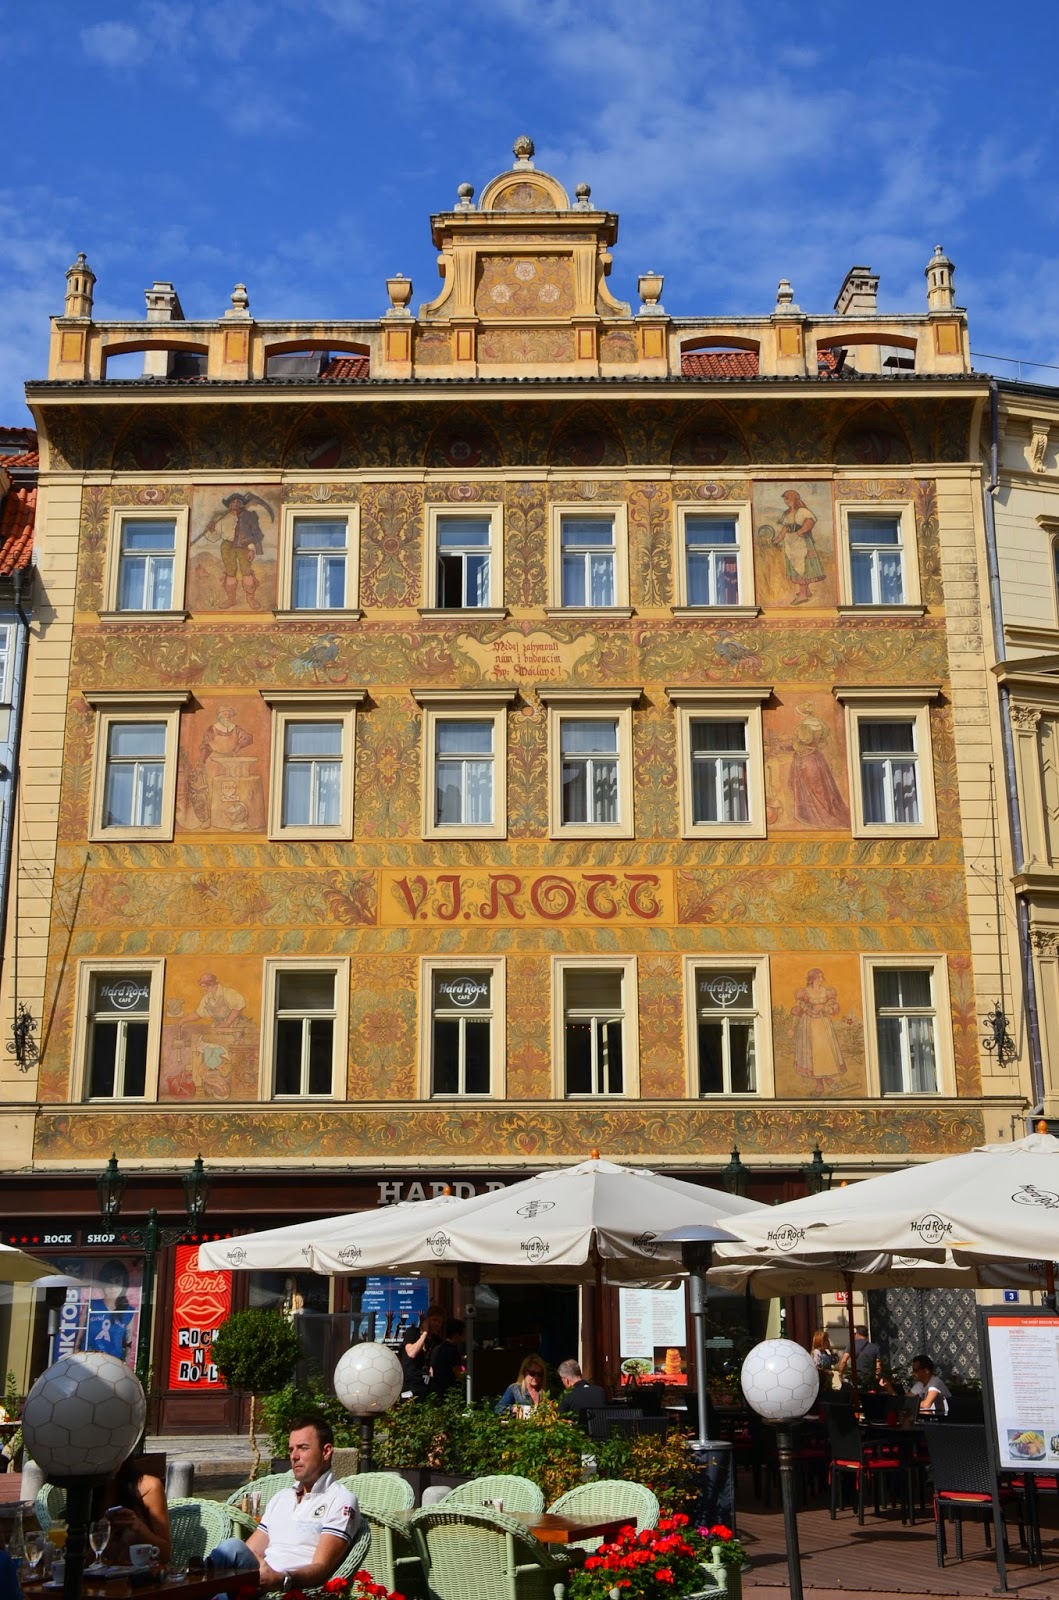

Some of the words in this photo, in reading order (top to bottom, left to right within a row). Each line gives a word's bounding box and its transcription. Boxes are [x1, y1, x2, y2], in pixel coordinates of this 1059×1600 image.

[101, 986, 126, 997] Hard
[126, 986, 149, 998] Rock
[439, 983, 464, 993] Hard
[464, 983, 488, 995] Rock
[700, 981, 725, 992] Hard
[725, 981, 748, 993] Rock
[910, 1220, 931, 1231] Hard
[932, 1220, 953, 1234] Rock
[44, 1235, 72, 1244] ROCK
[87, 1234, 116, 1243] SHOP
[767, 1230, 786, 1241] Hard
[786, 1228, 805, 1241] Rock
[426, 1237, 440, 1246] Hard
[439, 1236, 451, 1247] Rock
[520, 1241, 536, 1251] Hard
[535, 1241, 549, 1254] Rock
[337, 1249, 351, 1259] Hard
[350, 1248, 362, 1259] Rock
[178, 1272, 227, 1293] Drink
[179, 1362, 217, 1382] ROLL
